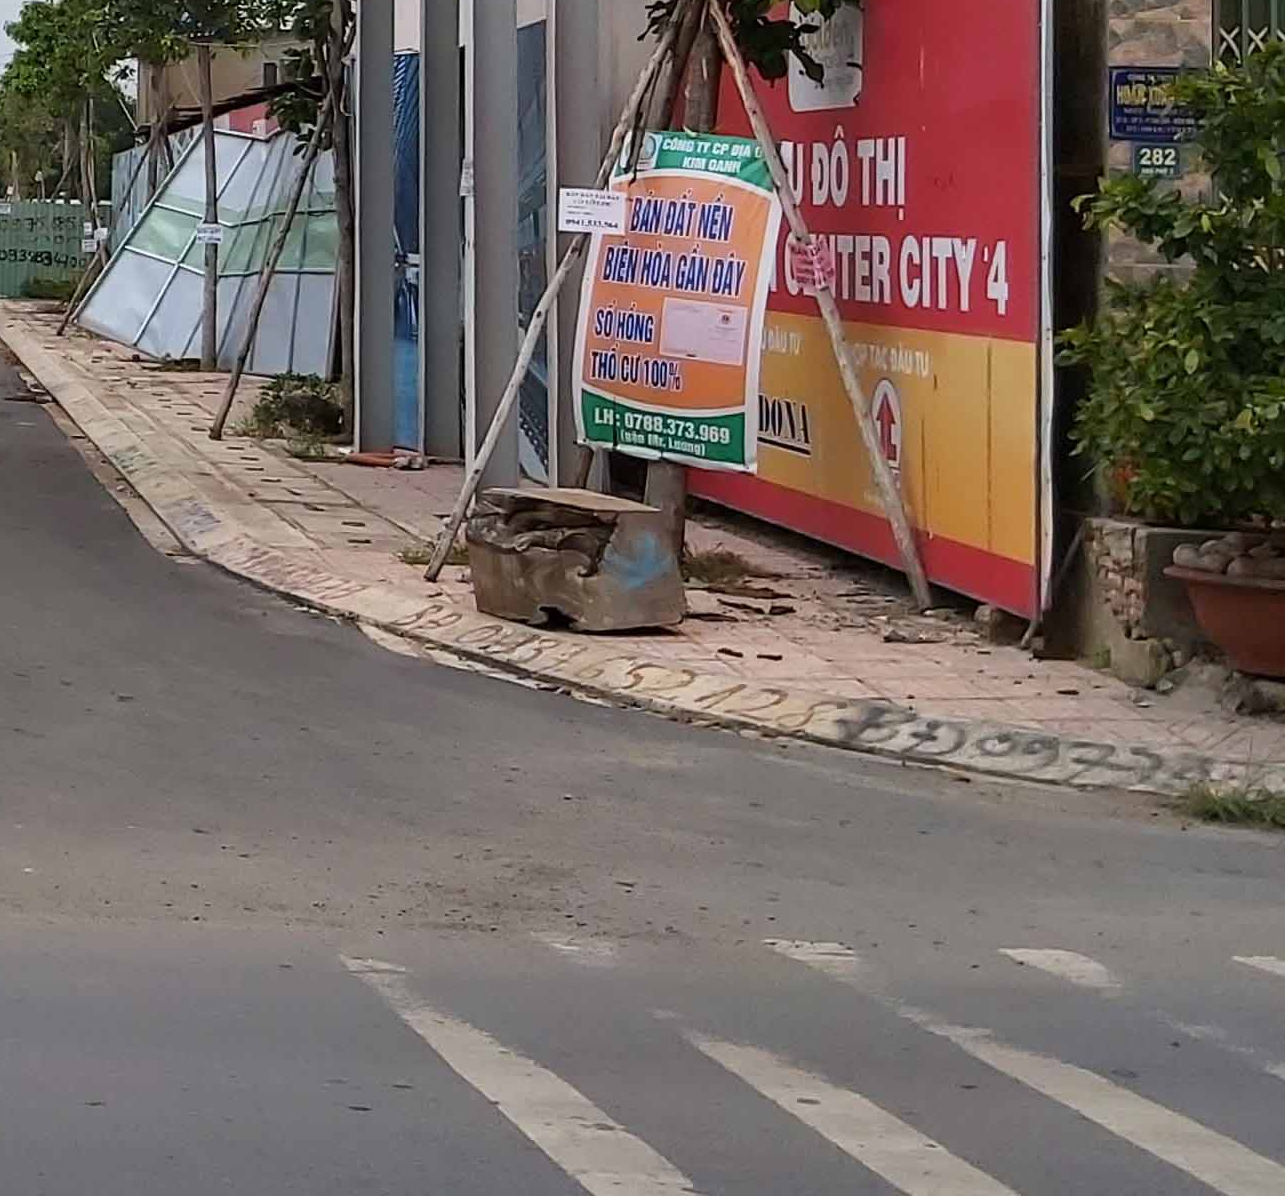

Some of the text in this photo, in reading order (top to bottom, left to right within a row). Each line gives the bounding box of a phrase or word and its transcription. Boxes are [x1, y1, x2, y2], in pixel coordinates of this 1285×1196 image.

[662, 137, 694, 152] CÔNG
[696, 141, 711, 153] TY
[712, 143, 730, 155] CP
[683, 155, 742, 173] KIM OANH
[1139, 148, 1176, 165] 282
[812, 125, 906, 221] ĐÔ THỊ
[630, 190, 663, 235] BÁN
[663, 188, 697, 238] ĐẤT
[697, 193, 734, 242] NỀN
[602, 240, 639, 285] BIÊN
[640, 240, 670, 288] HÒA
[675, 244, 707, 293] GẦN
[711, 251, 745, 298] ĐÂY
[899, 235, 977, 312] CITY
[988, 238, 1009, 315] 4
[594, 300, 655, 344] SỔ HỒNG
[591, 343, 682, 391] THỔ CƯ 100%
[624, 411, 730, 445] 0788.373.969
